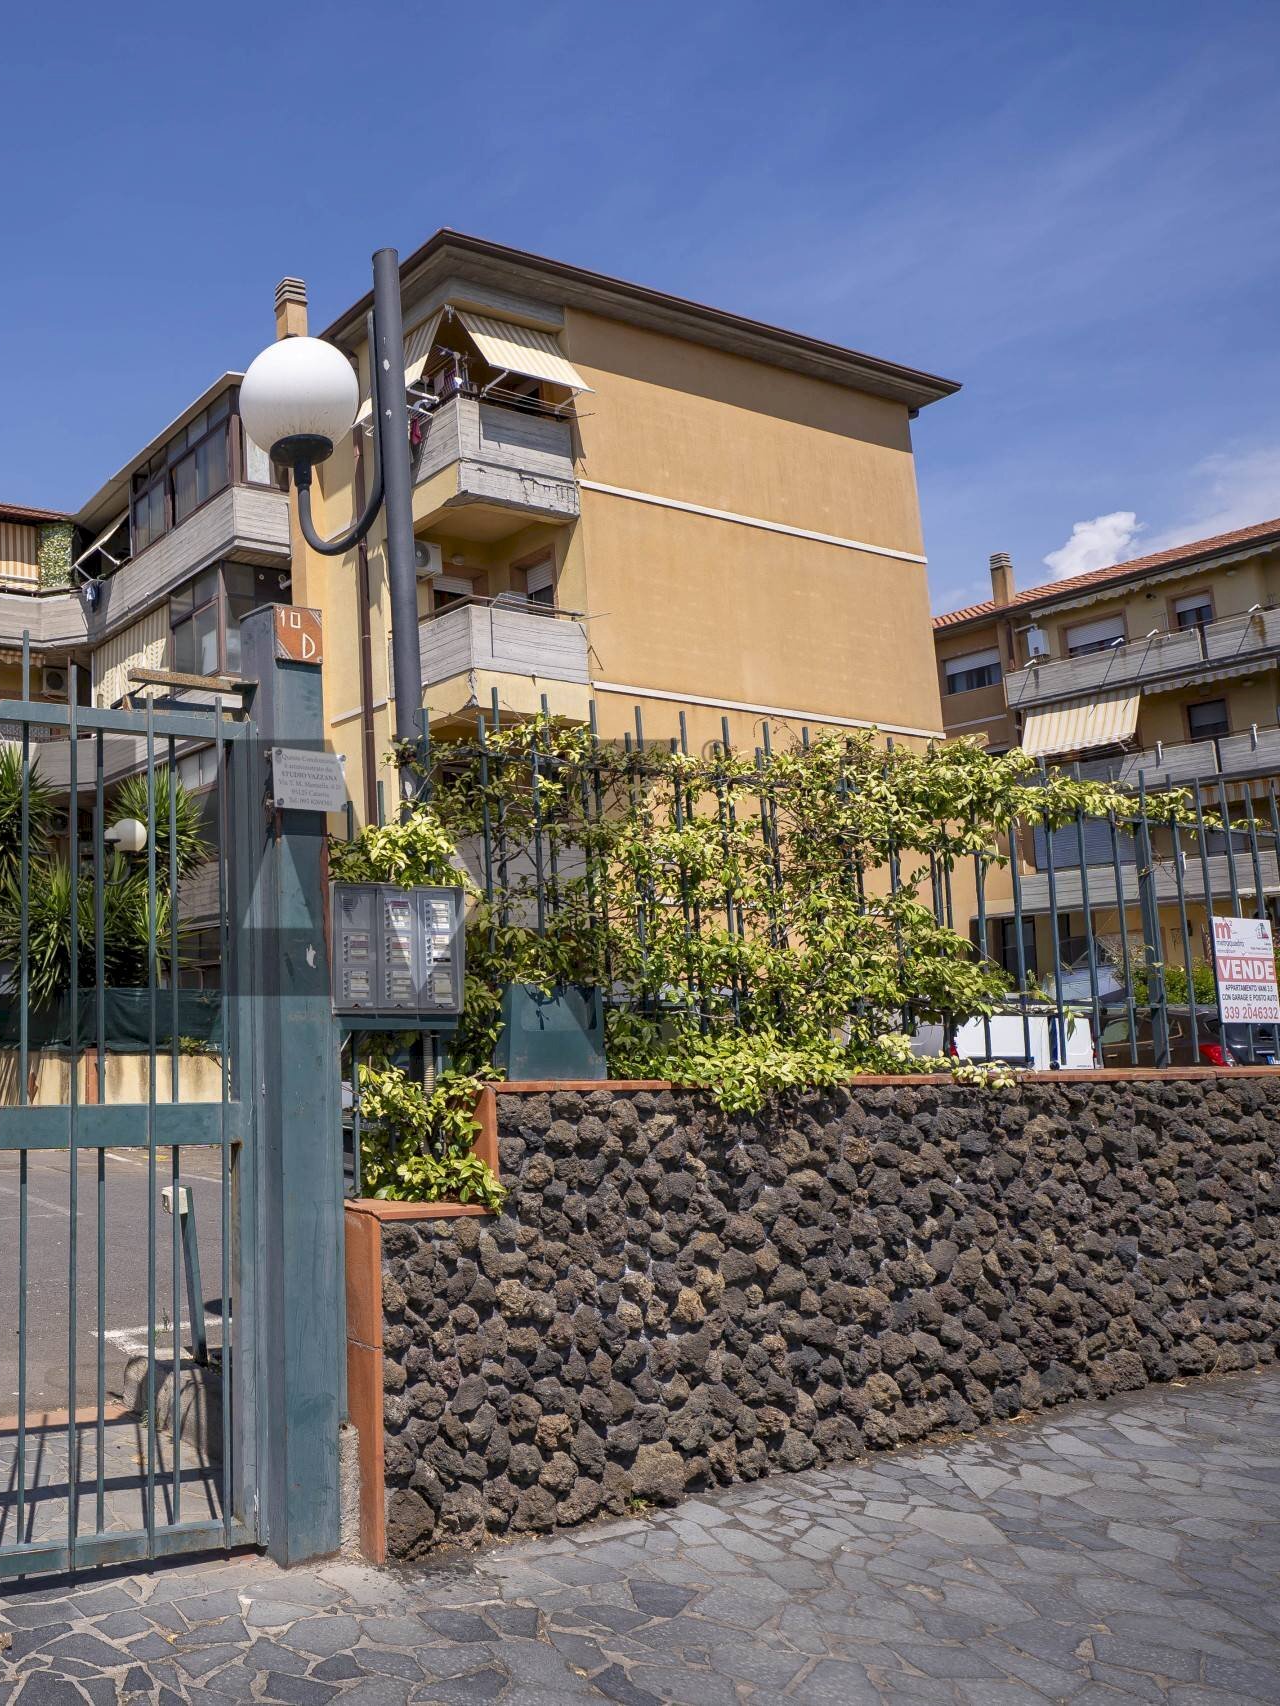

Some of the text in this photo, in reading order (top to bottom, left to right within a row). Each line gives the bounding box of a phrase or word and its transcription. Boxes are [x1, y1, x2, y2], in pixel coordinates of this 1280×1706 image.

[280, 608, 301, 629] 10
[302, 632, 316, 659] D
[281, 770, 306, 779] STUDIO
[1218, 959, 1275, 981] VENDE
[1225, 984, 1257, 992] APPARTAMENTO
[1222, 993, 1231, 1001] CON
[1232, 993, 1248, 1001] GARAGE
[1267, 994, 1278, 1002] AUTO
[1224, 1006, 1279, 1020] 339 2046332
